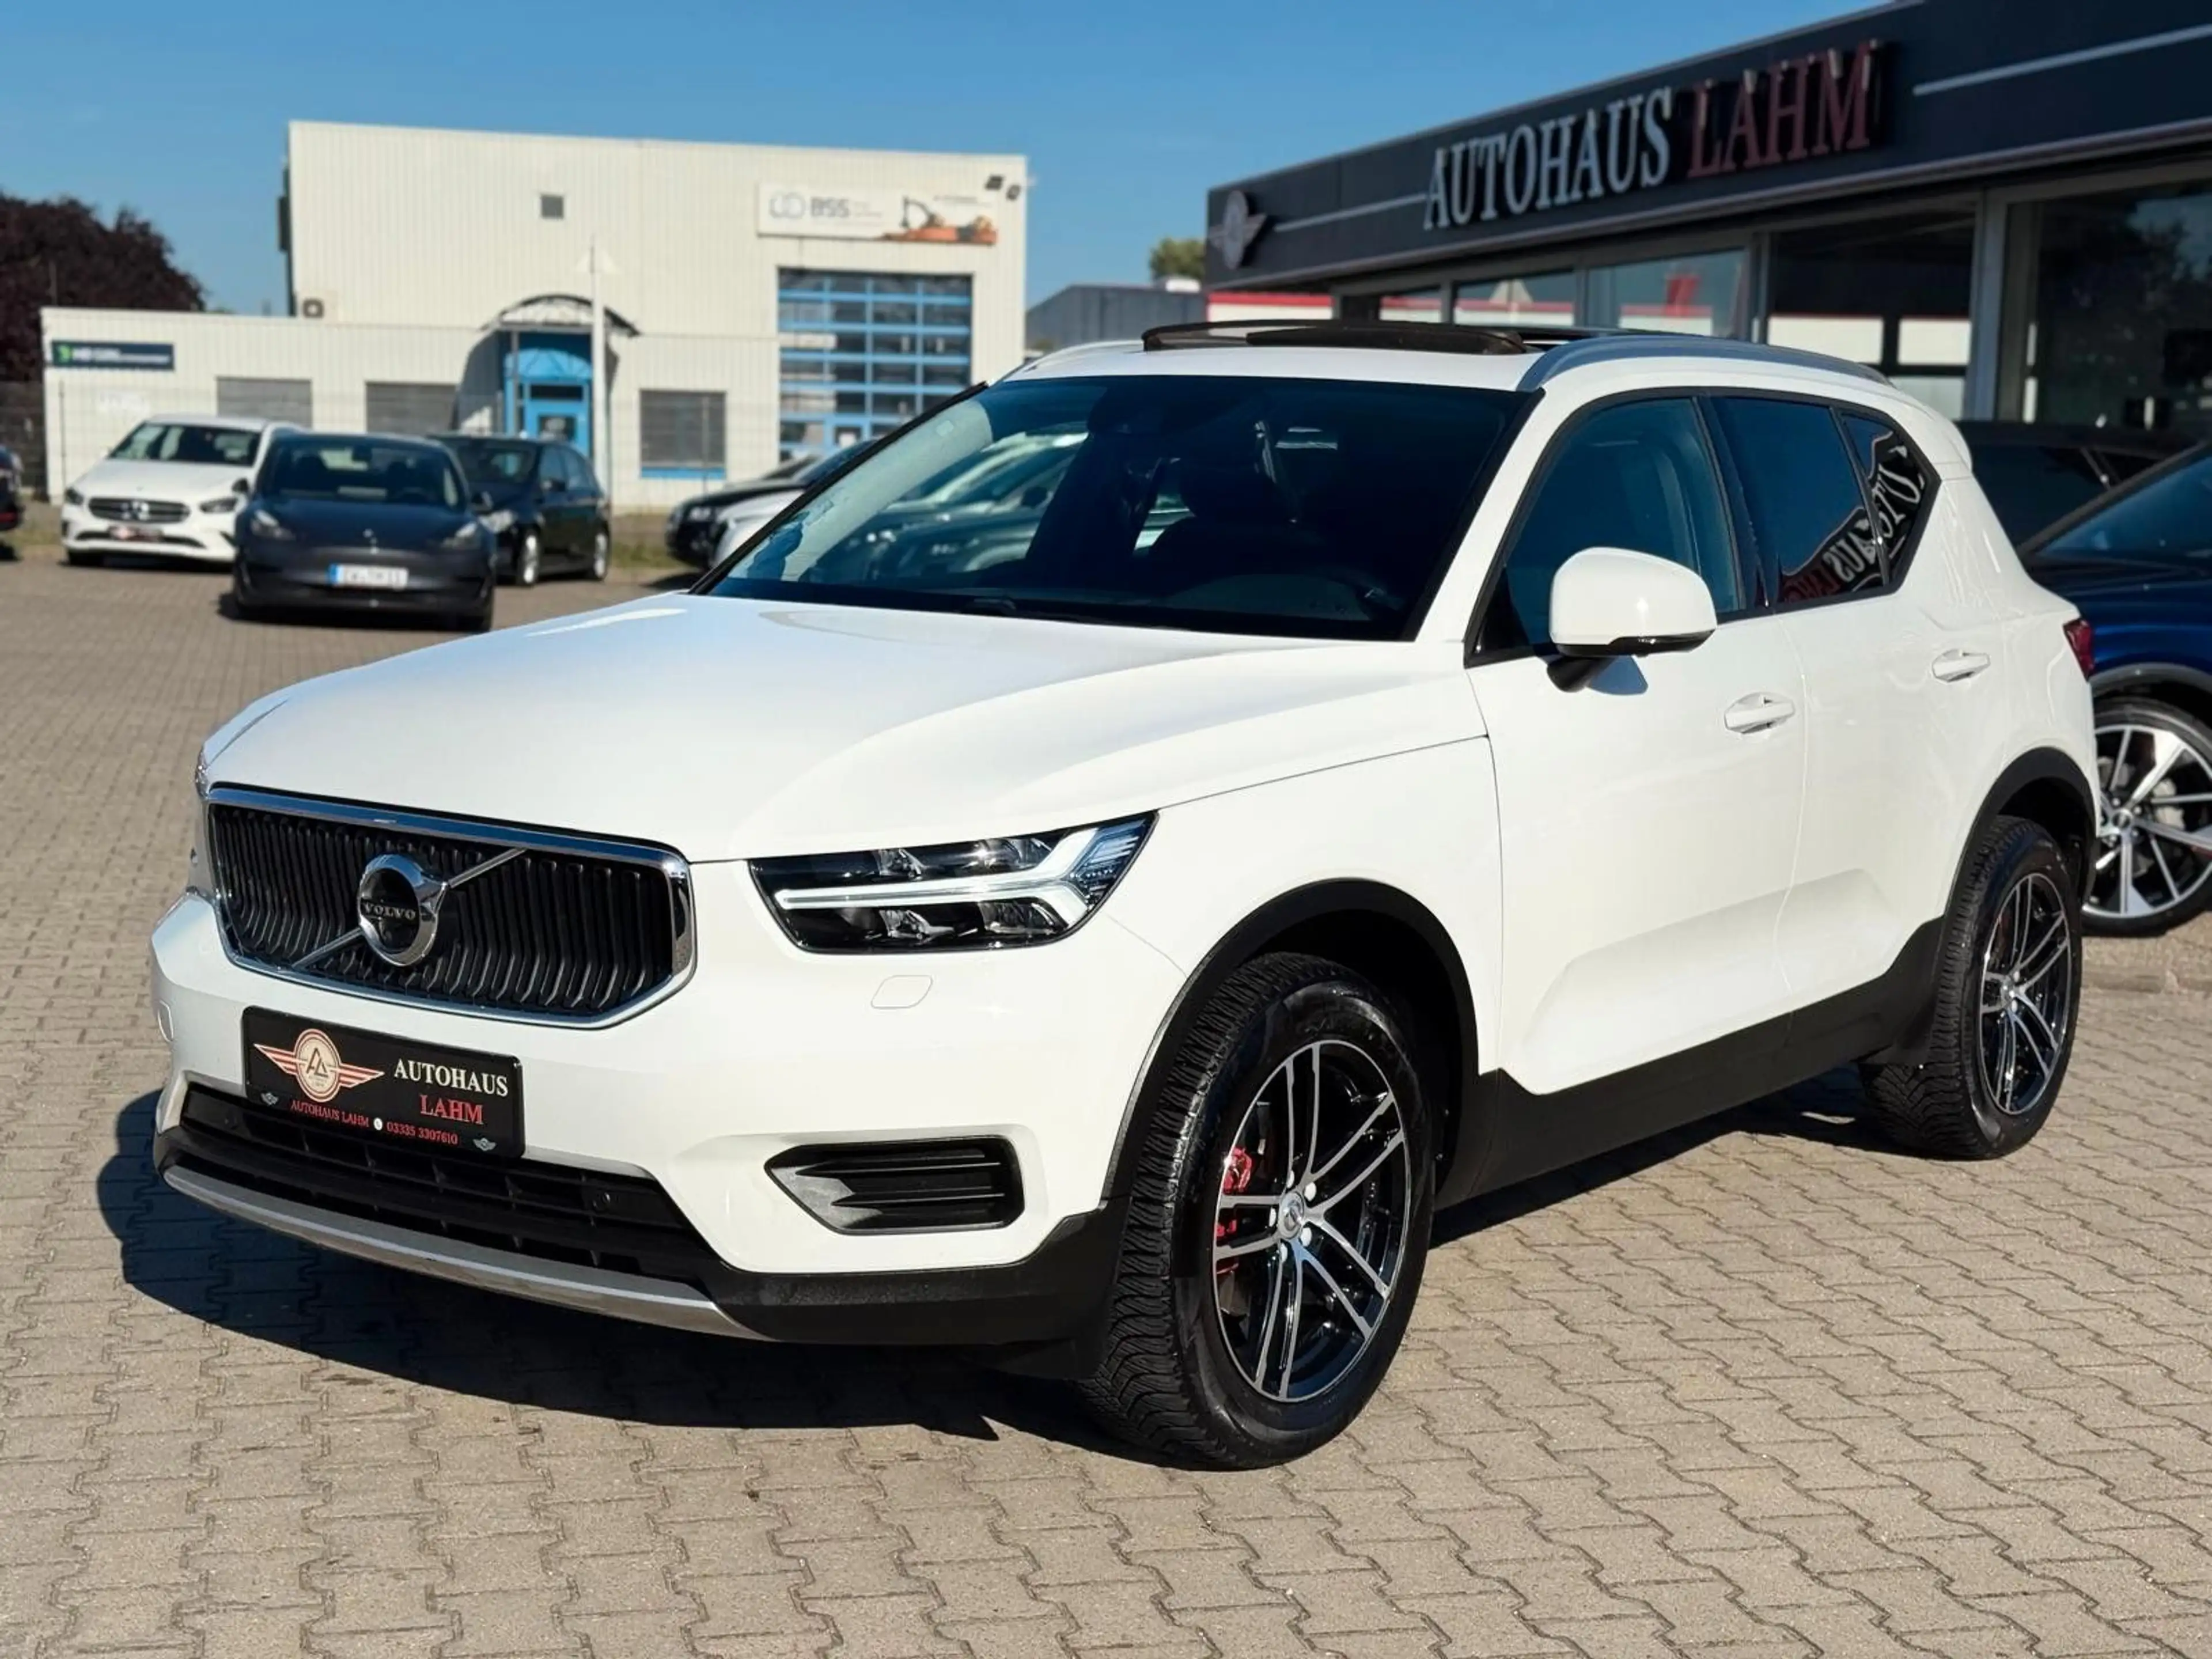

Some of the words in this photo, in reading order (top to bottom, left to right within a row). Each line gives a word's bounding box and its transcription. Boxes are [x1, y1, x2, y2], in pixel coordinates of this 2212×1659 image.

[1423, 86, 1671, 230] AUTOHAUS
[1687, 39, 1879, 177] LAHM
[363, 901, 416, 921] VOLVO
[394, 1058, 509, 1097] AUTOHAUS
[290, 1099, 340, 1121] AUTOHAUS
[342, 1111, 369, 1128] LAHM
[420, 1094, 484, 1125] LAHM
